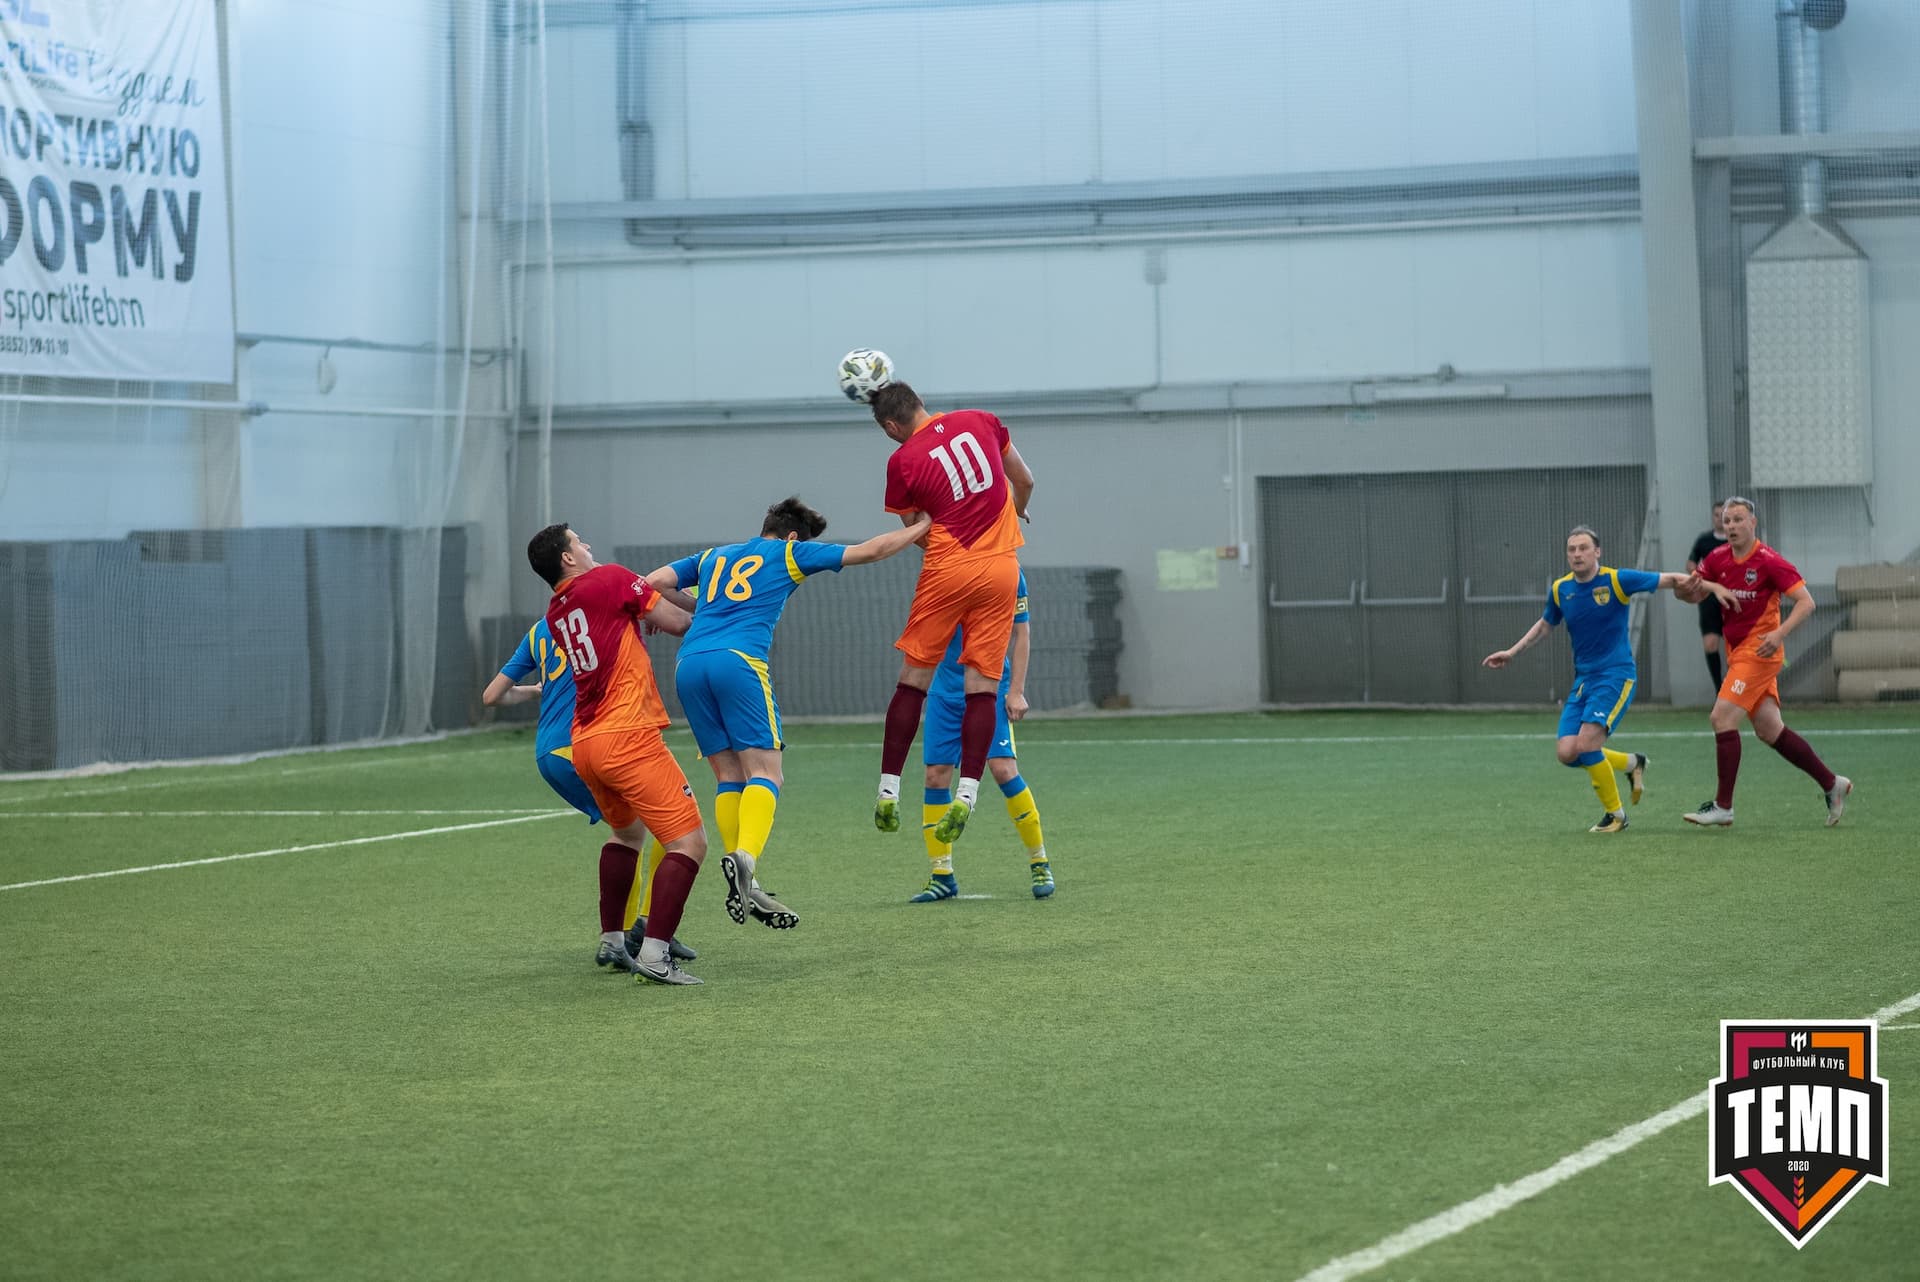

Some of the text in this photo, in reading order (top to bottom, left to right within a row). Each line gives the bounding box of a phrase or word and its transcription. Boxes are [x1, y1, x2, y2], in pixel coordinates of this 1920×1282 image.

[0, 39, 79, 79] rtLife
[3, 283, 146, 331] sportlifebrn
[928, 431, 994, 502] 10
[706, 555, 763, 603] 18
[554, 607, 598, 675] 13
